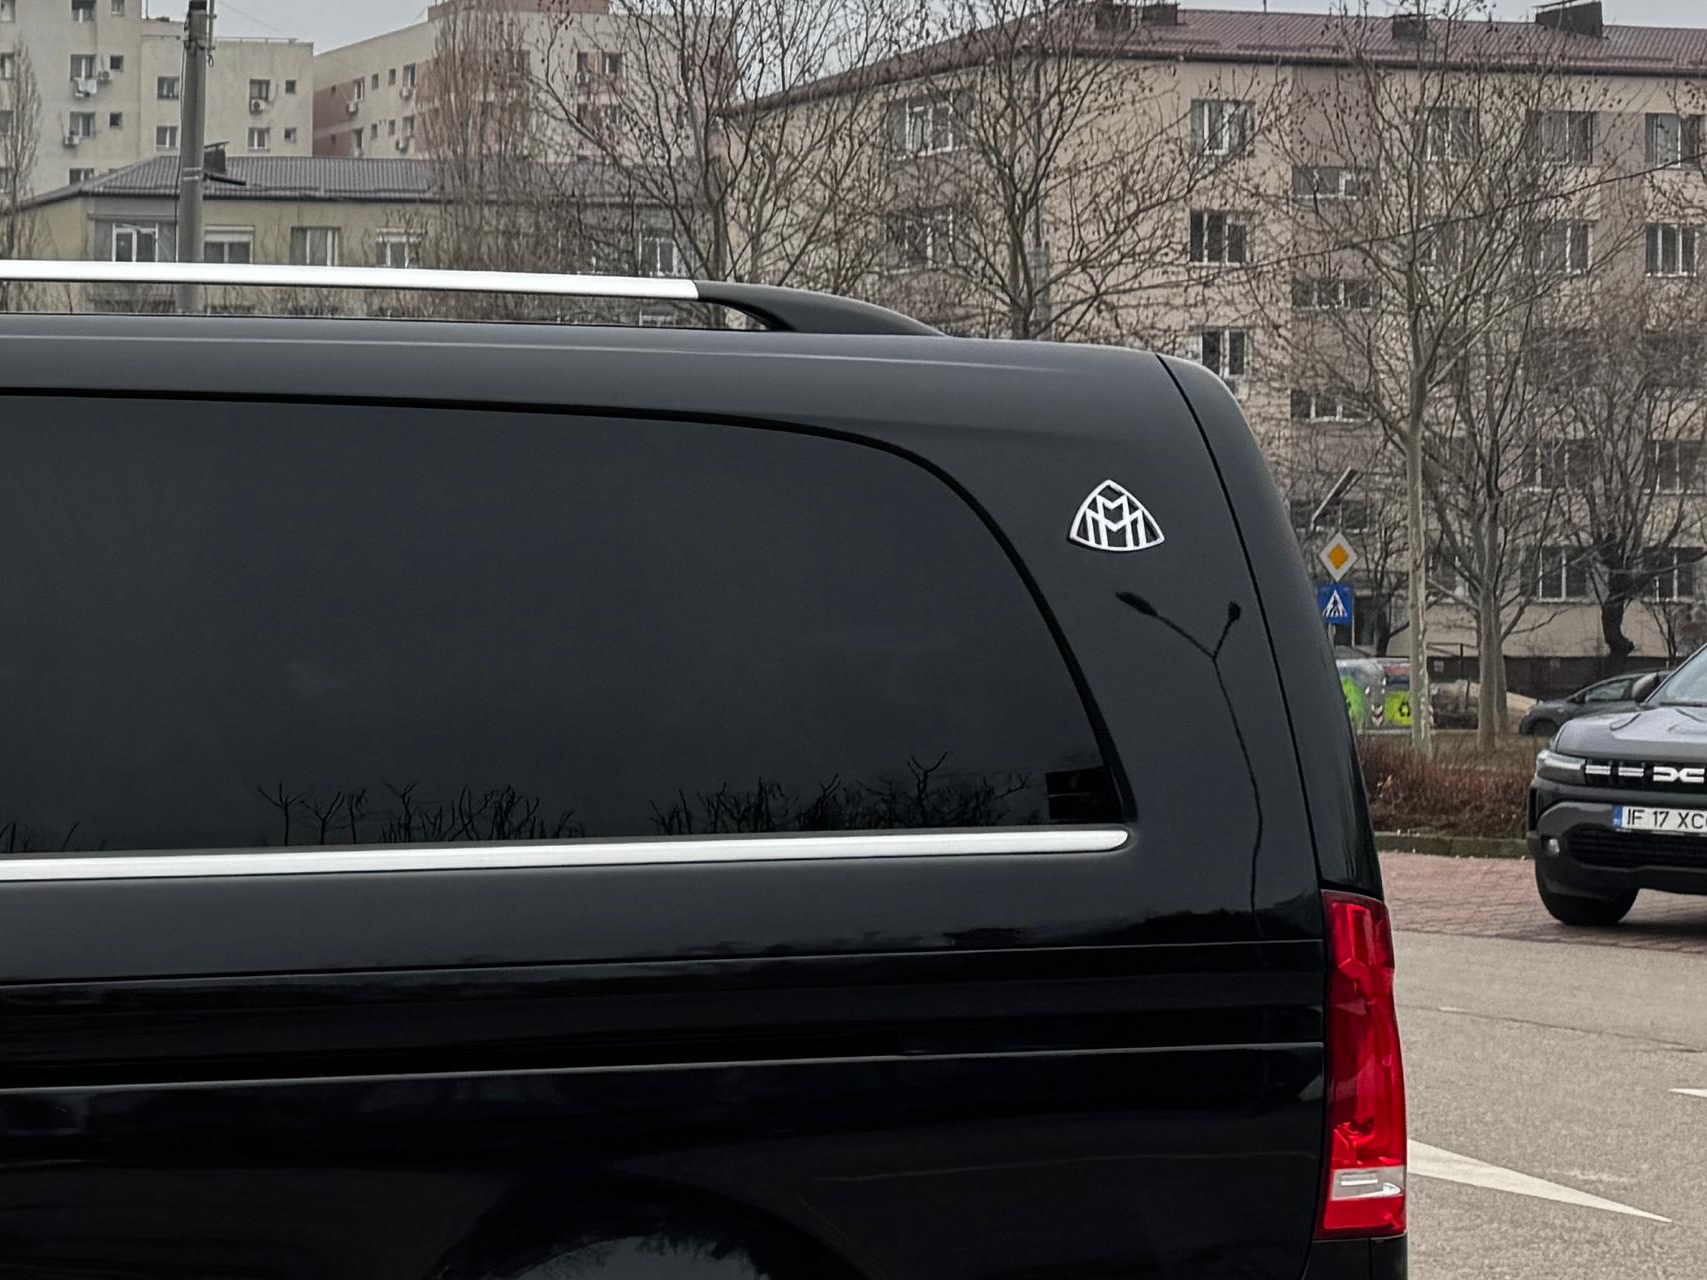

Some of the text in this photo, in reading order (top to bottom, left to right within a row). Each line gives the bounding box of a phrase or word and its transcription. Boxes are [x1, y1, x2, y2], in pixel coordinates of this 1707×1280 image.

[1627, 807, 1646, 825] IF
[1652, 810, 1670, 828] 17
[1677, 811, 1707, 830] XC
